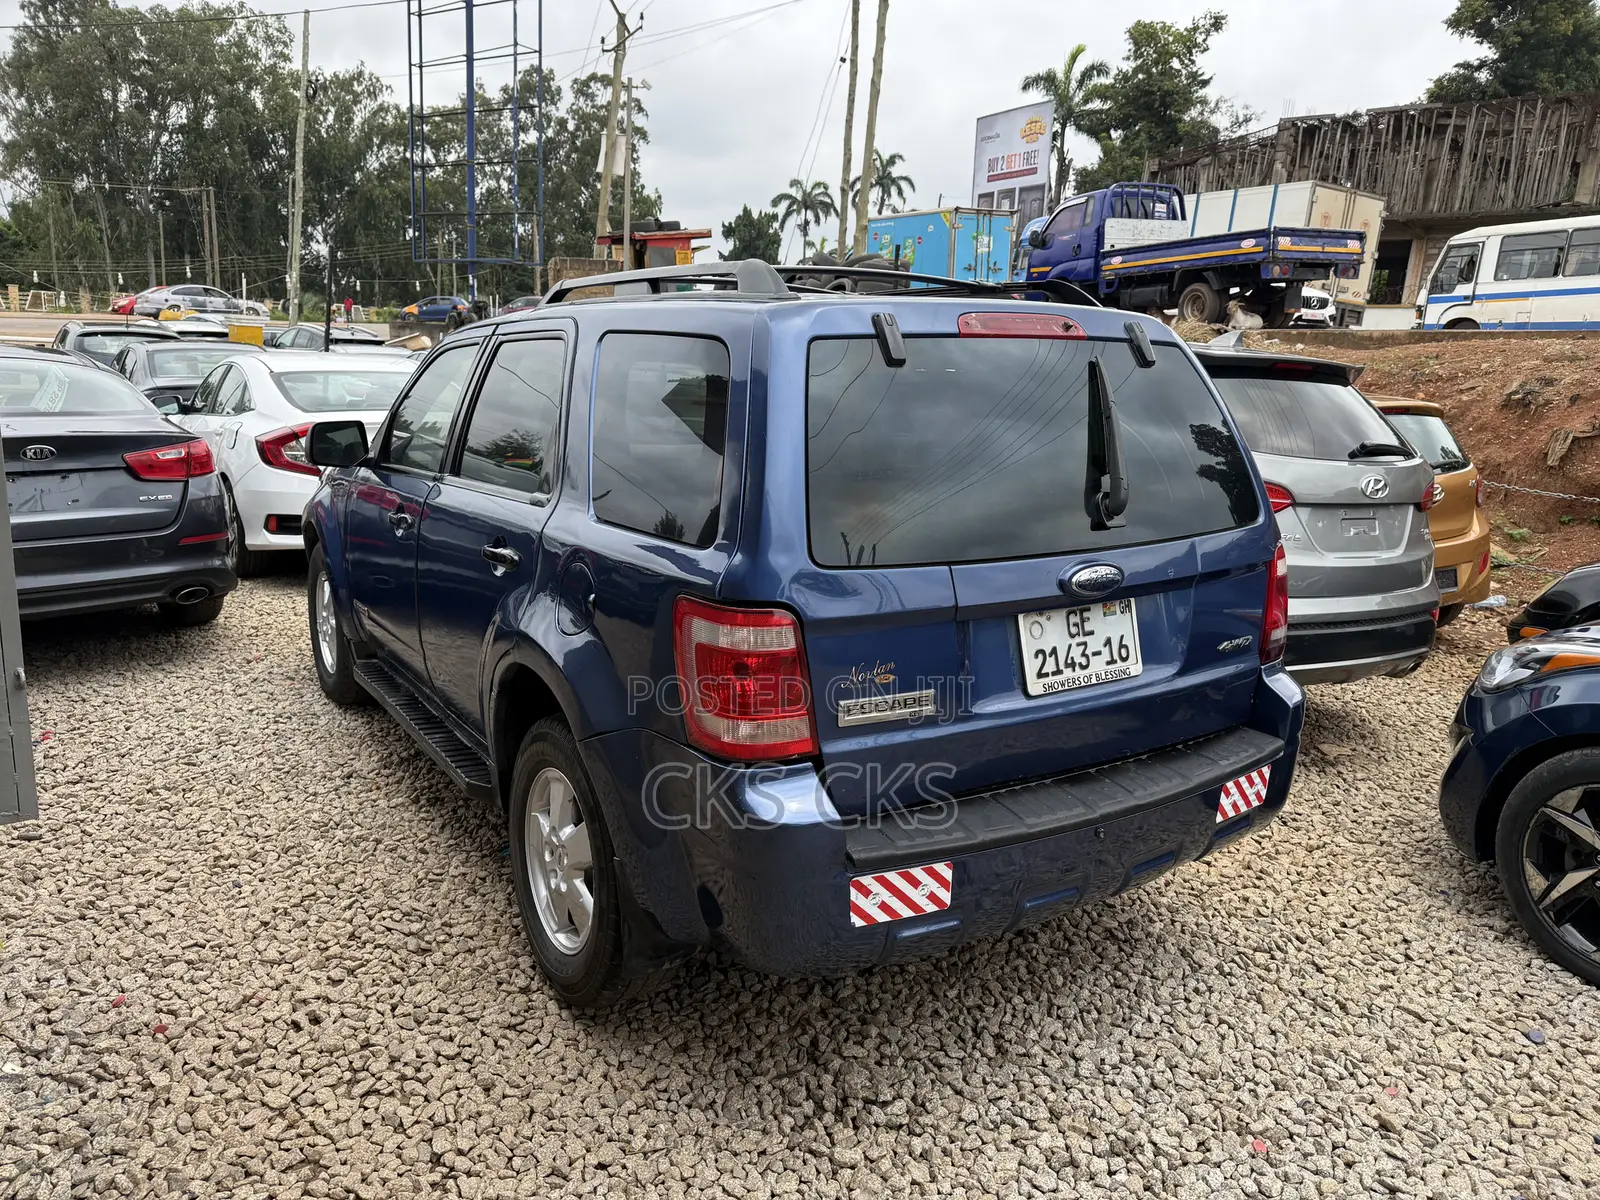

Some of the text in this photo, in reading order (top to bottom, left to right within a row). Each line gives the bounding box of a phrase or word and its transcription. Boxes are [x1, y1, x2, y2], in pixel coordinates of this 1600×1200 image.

[987, 149, 1040, 174] BUY 2 GET 1 FREE!
[25, 448, 51, 459] KIA
[1065, 599, 1131, 639] GE GH
[1034, 634, 1130, 680] 2143-16
[1042, 667, 1131, 693] SHOWERS OF BLESSING
[846, 695, 930, 717] ESCAPE
